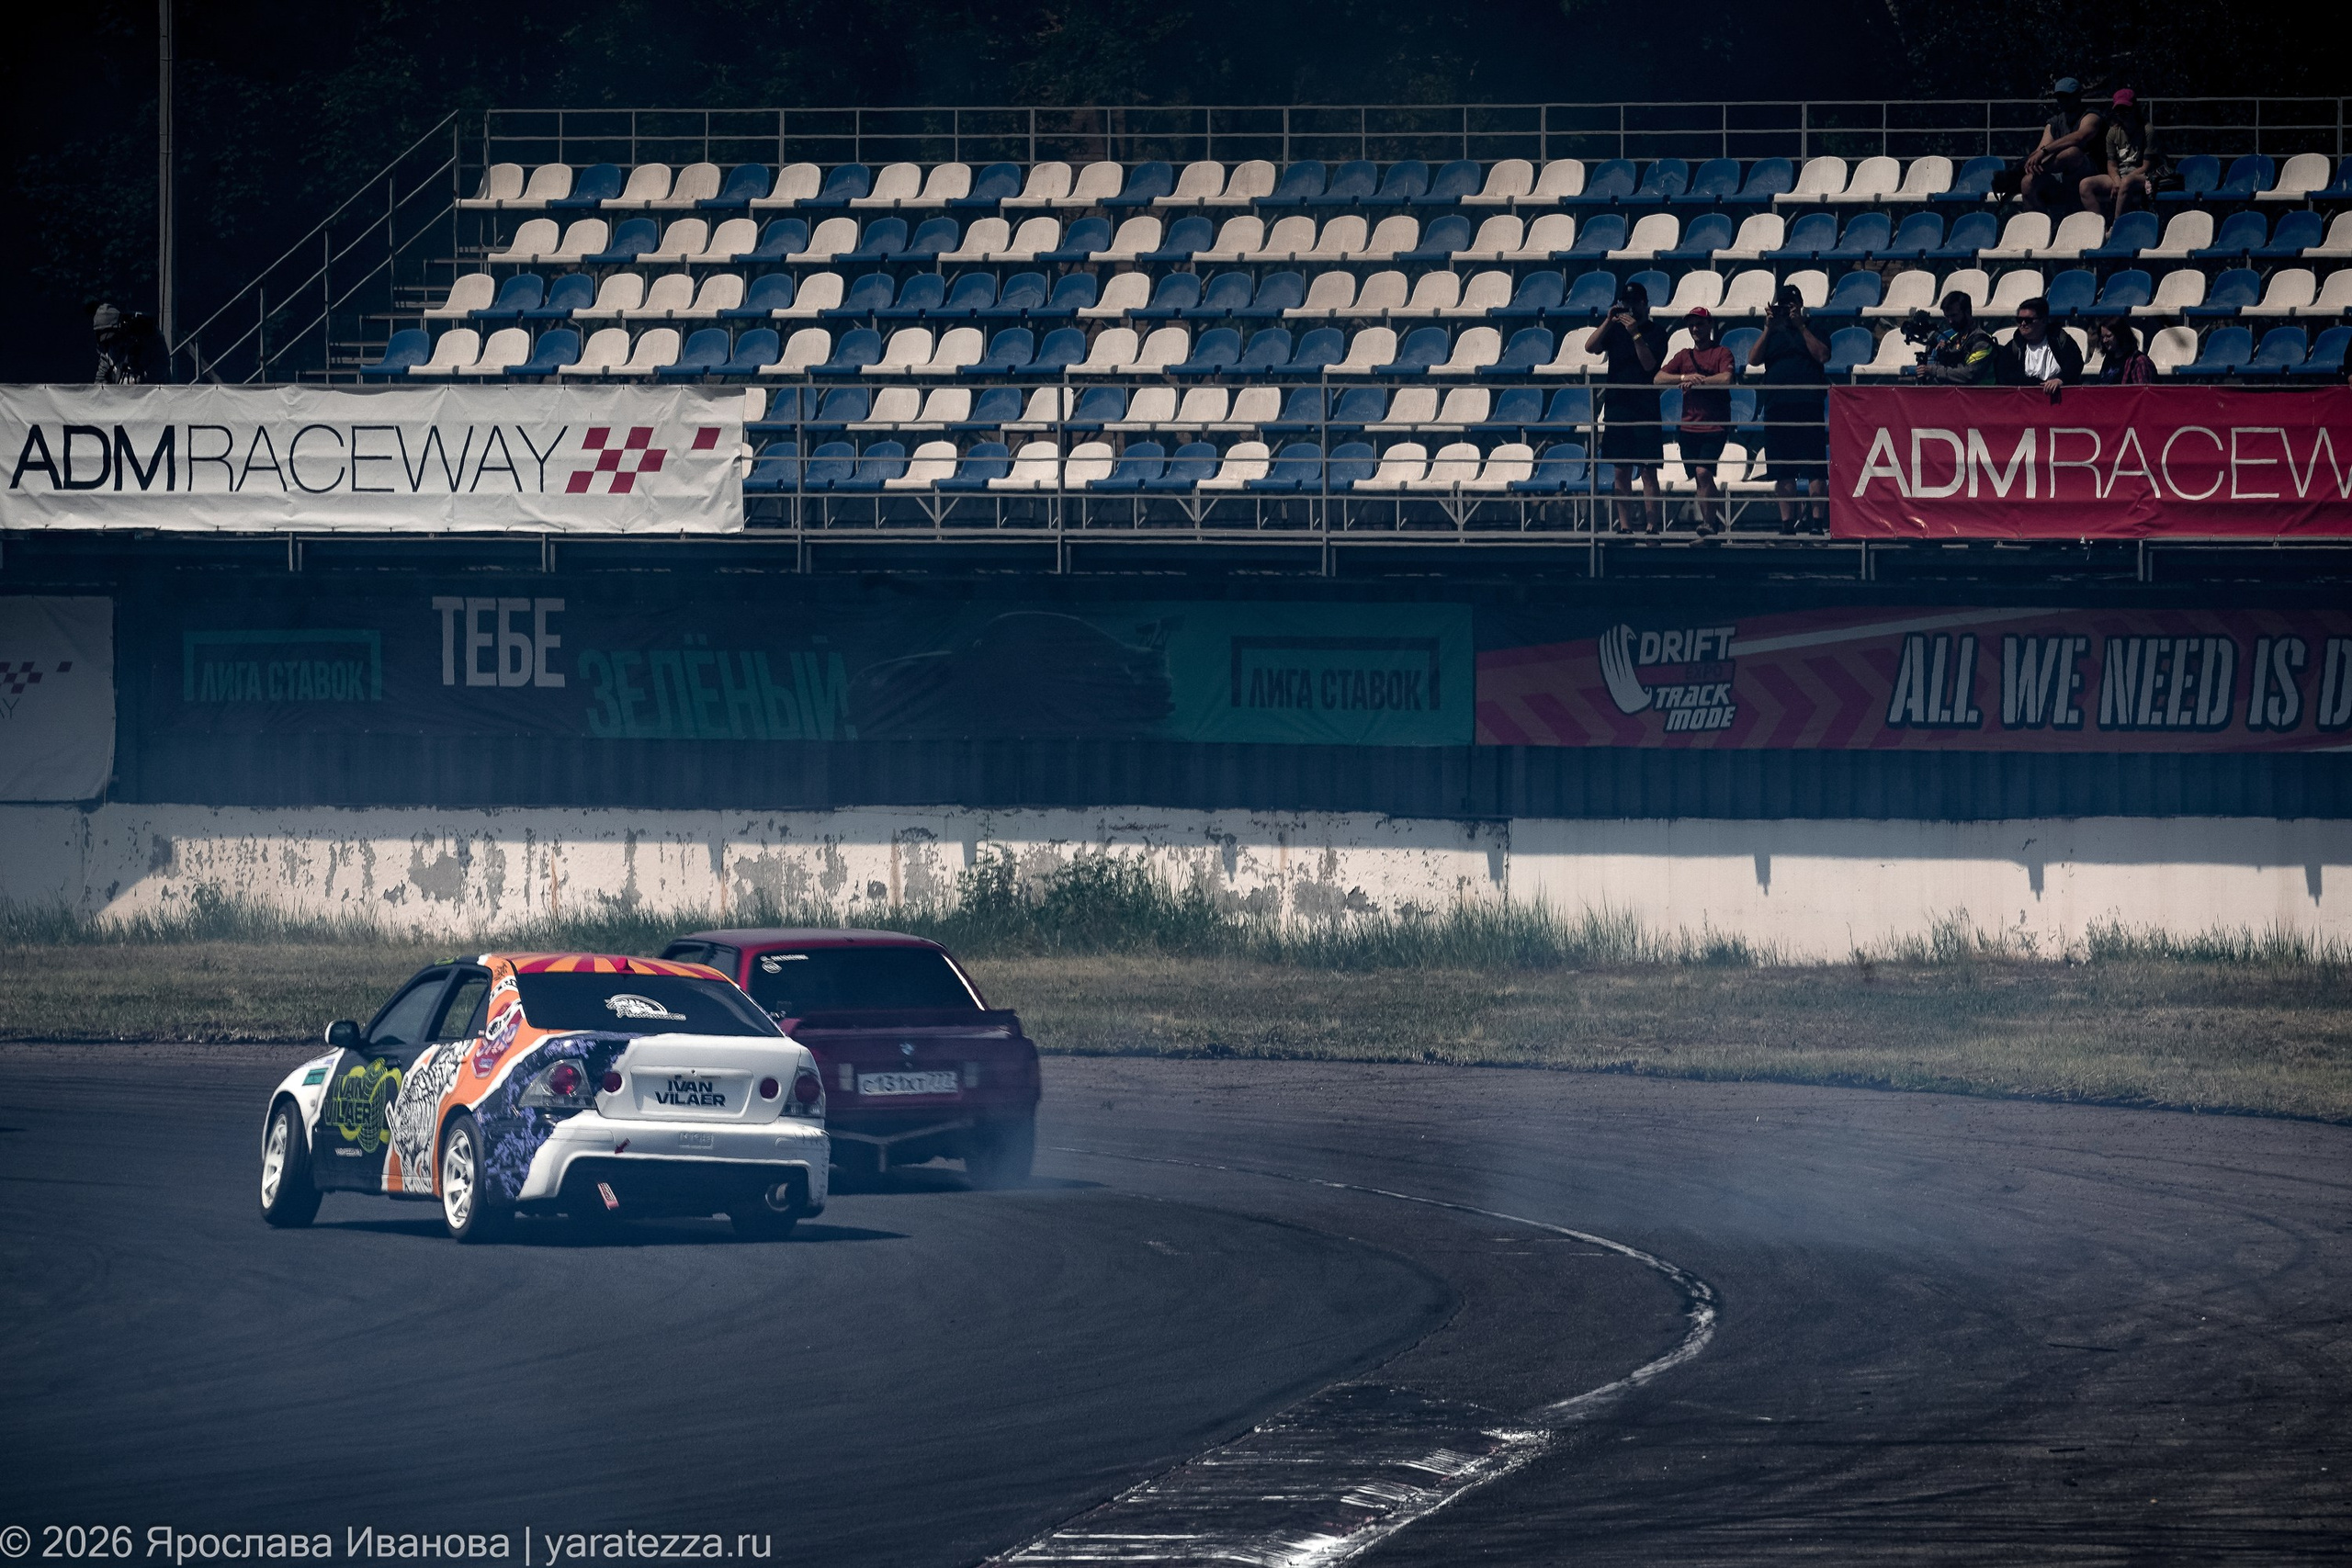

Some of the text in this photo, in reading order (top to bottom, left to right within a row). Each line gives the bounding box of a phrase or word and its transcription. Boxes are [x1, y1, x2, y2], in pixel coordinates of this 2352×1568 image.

[432, 596, 566, 687] ТЕБЕ
[1638, 626, 1736, 665] DRIFT
[200, 660, 365, 702] ЛИГА СТАВОК
[1249, 667, 1422, 711] ЛИГА СТАВОК
[1655, 682, 1732, 710] TRACK
[1888, 636, 1978, 724] ALL
[2003, 637, 2086, 725] WE
[2099, 637, 2233, 726] NEED
[2248, 637, 2305, 727] IS
[1666, 705, 1737, 731] MODE
[654, 1090, 727, 1108] VILAER
[667, 1079, 714, 1093] IVAN
